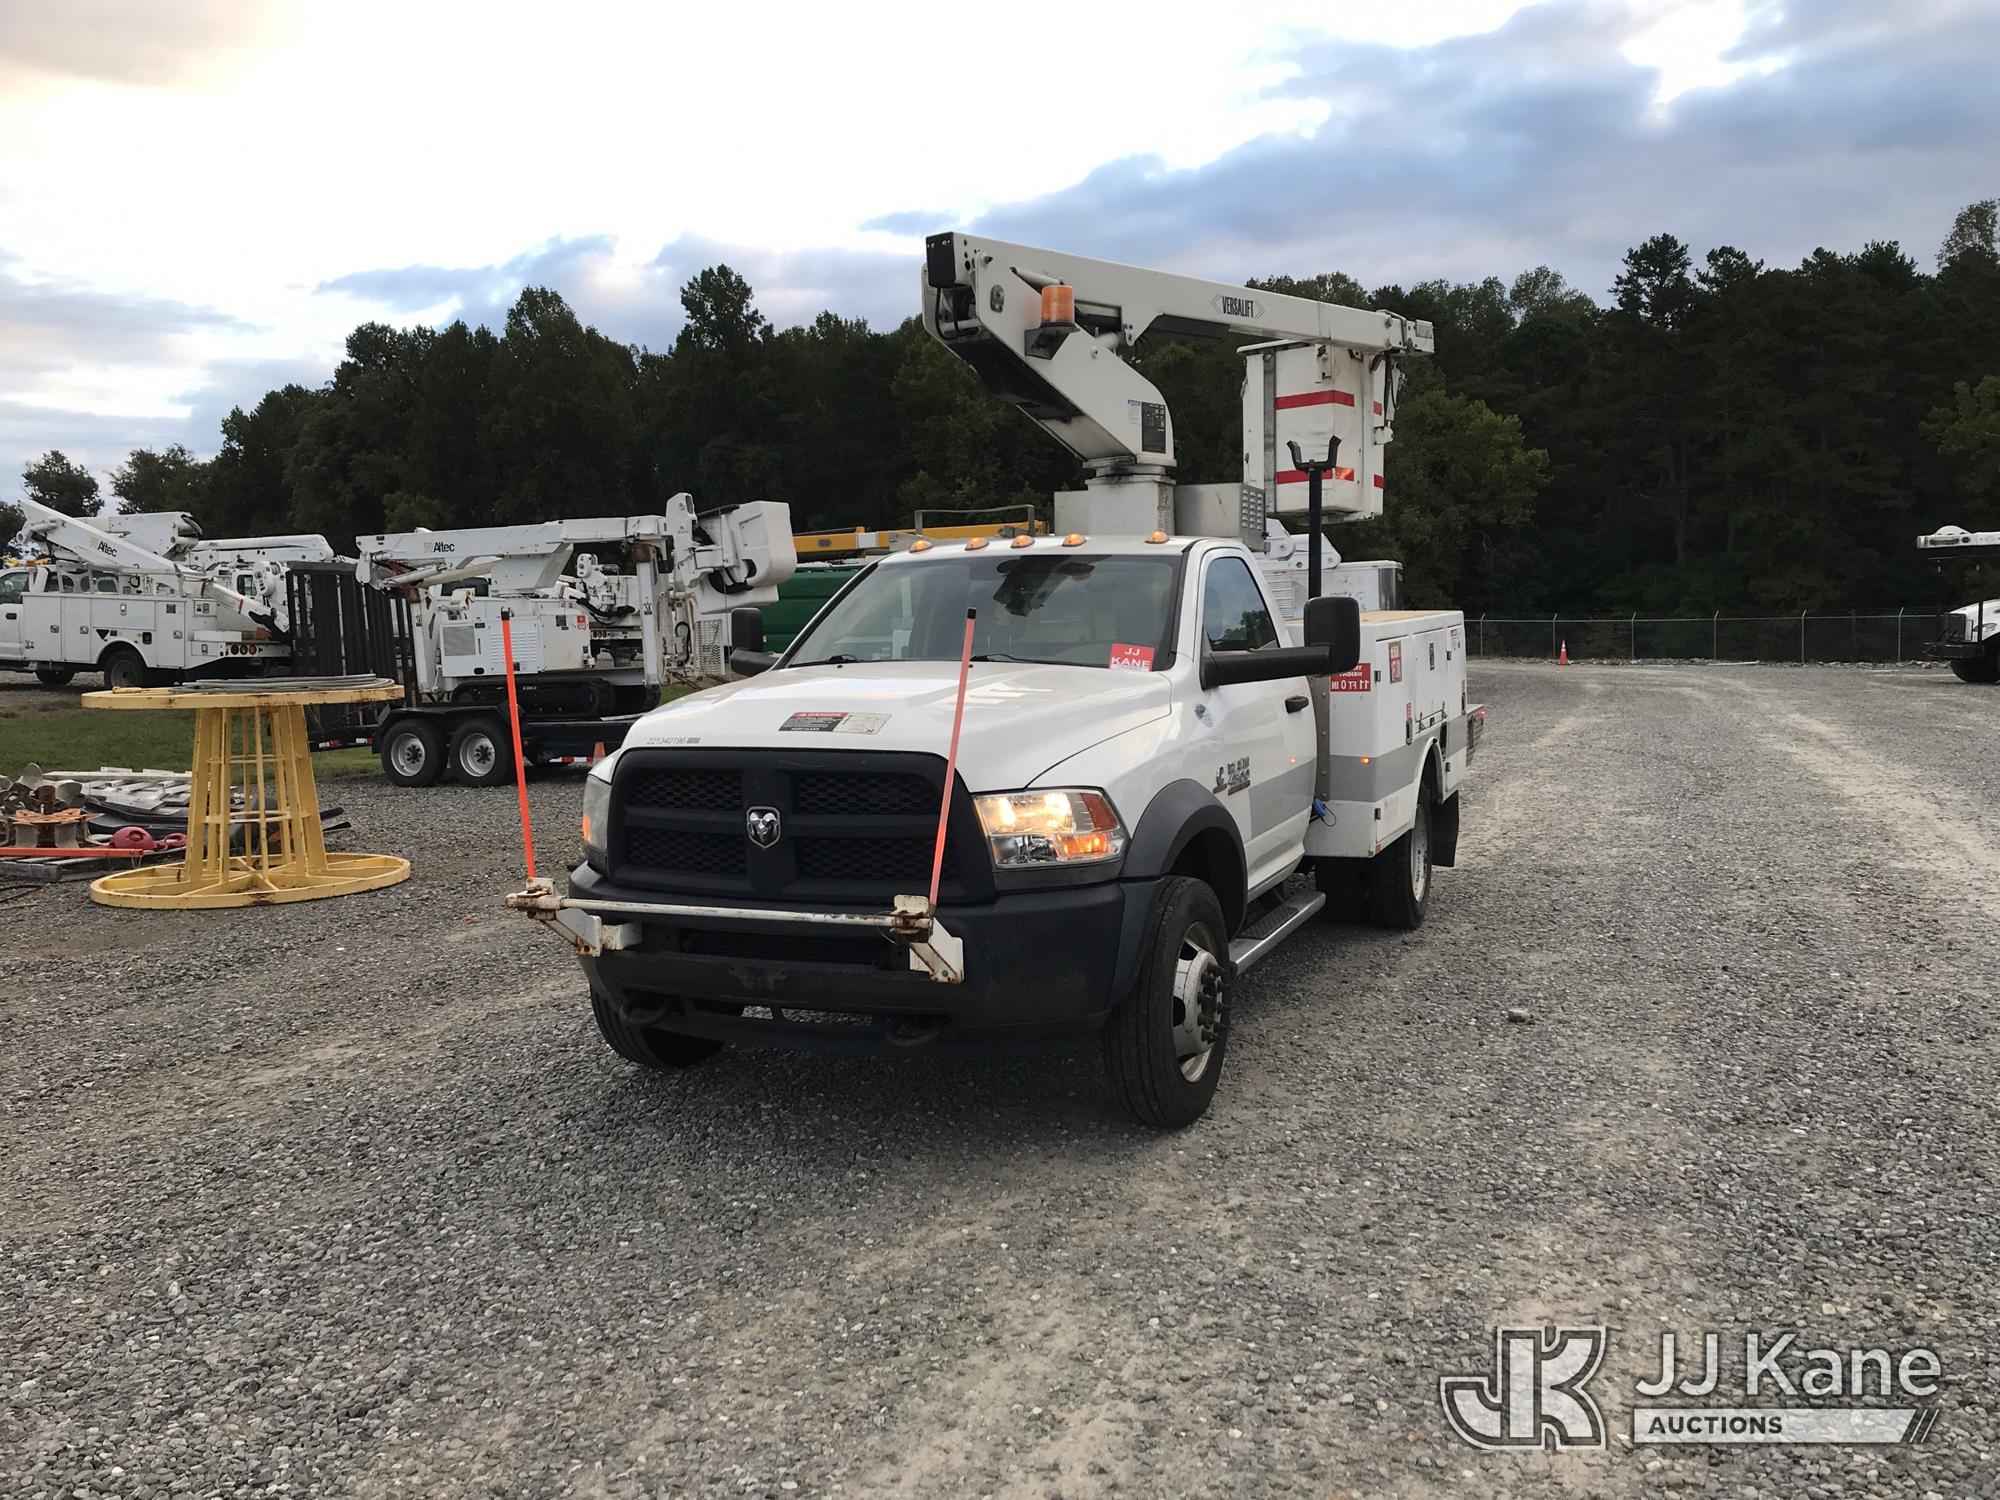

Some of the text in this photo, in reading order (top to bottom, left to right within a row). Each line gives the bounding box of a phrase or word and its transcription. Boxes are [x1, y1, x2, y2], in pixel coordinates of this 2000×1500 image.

[1222, 296, 1254, 318] VERSALIFT
[97, 540, 118, 558] Altec
[433, 541, 455, 553] Altec
[1124, 647, 1141, 656] JJ
[1111, 656, 1151, 669] KANE
